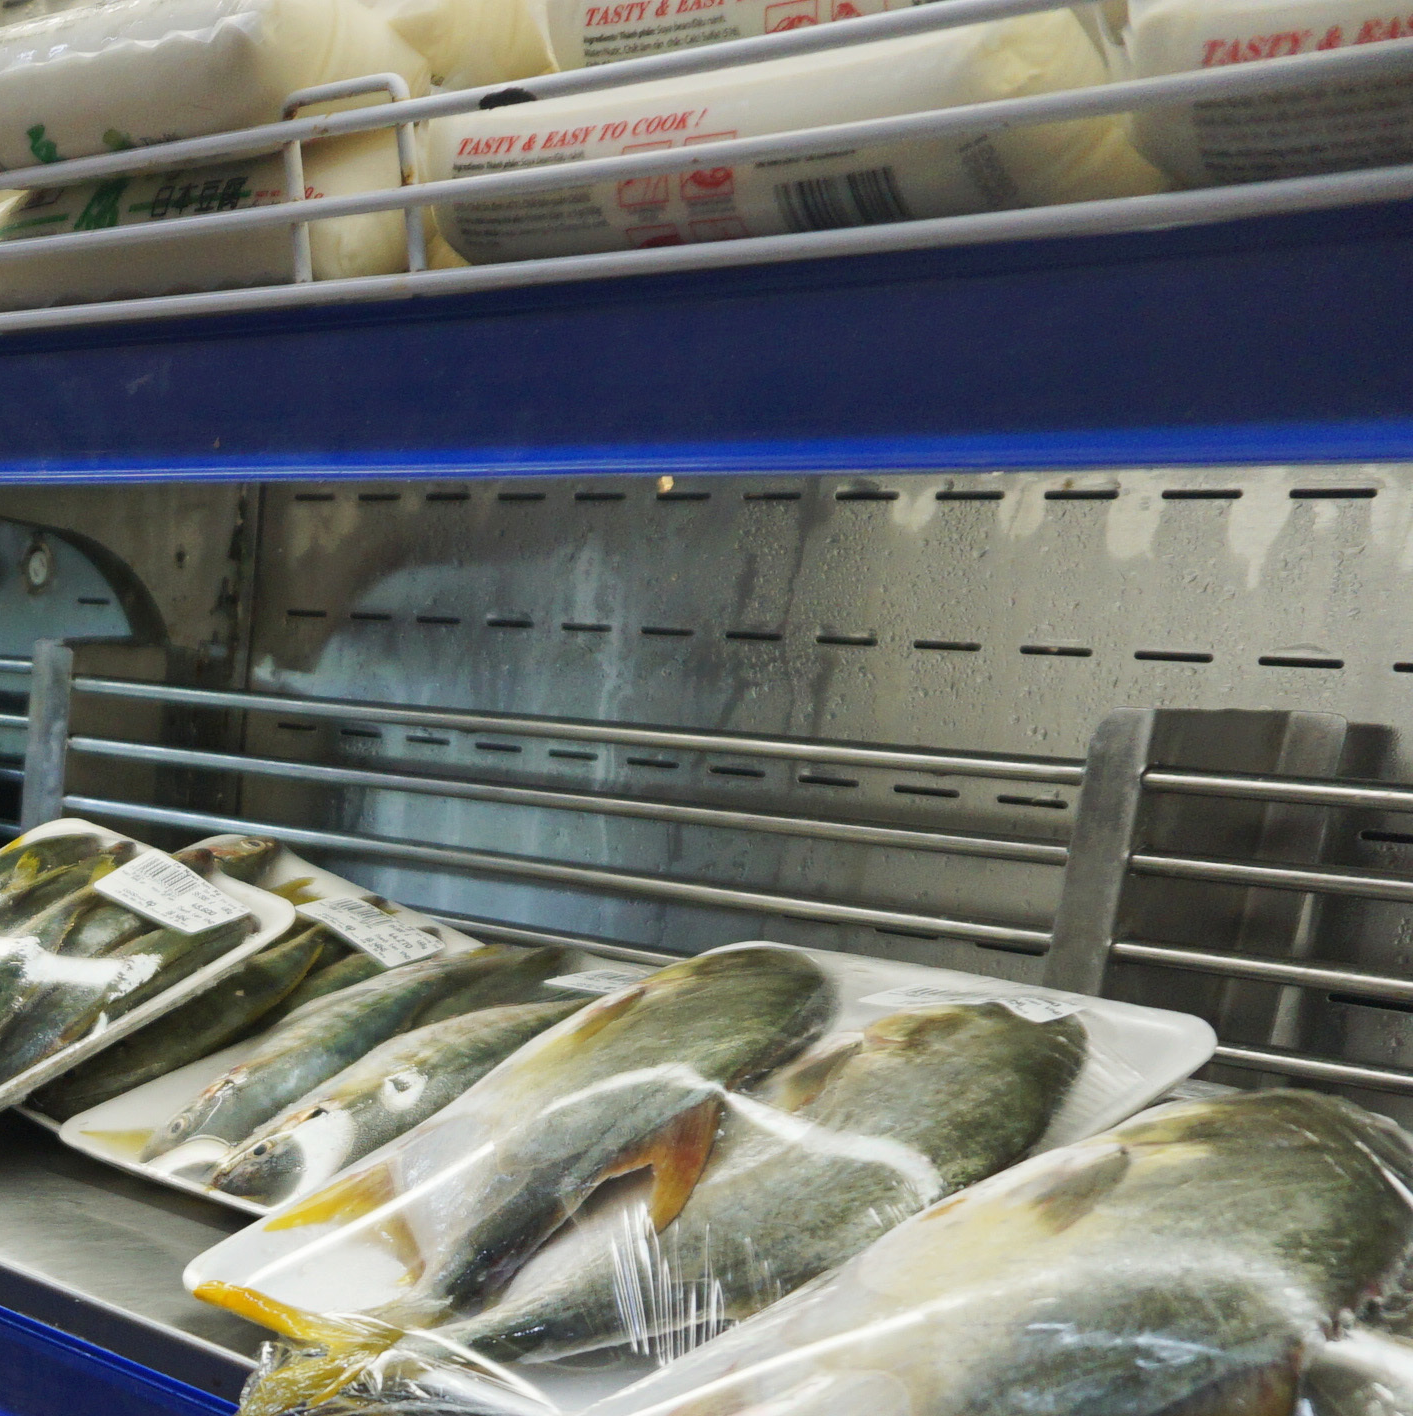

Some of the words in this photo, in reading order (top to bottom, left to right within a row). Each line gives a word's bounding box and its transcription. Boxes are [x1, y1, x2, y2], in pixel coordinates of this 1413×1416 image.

[585, 4, 650, 27] TASTY
[457, 134, 521, 156] TASTY
[522, 134, 538, 151] &
[541, 125, 597, 149] EASY
[598, 120, 627, 142] TO
[632, 111, 696, 136] COOK
